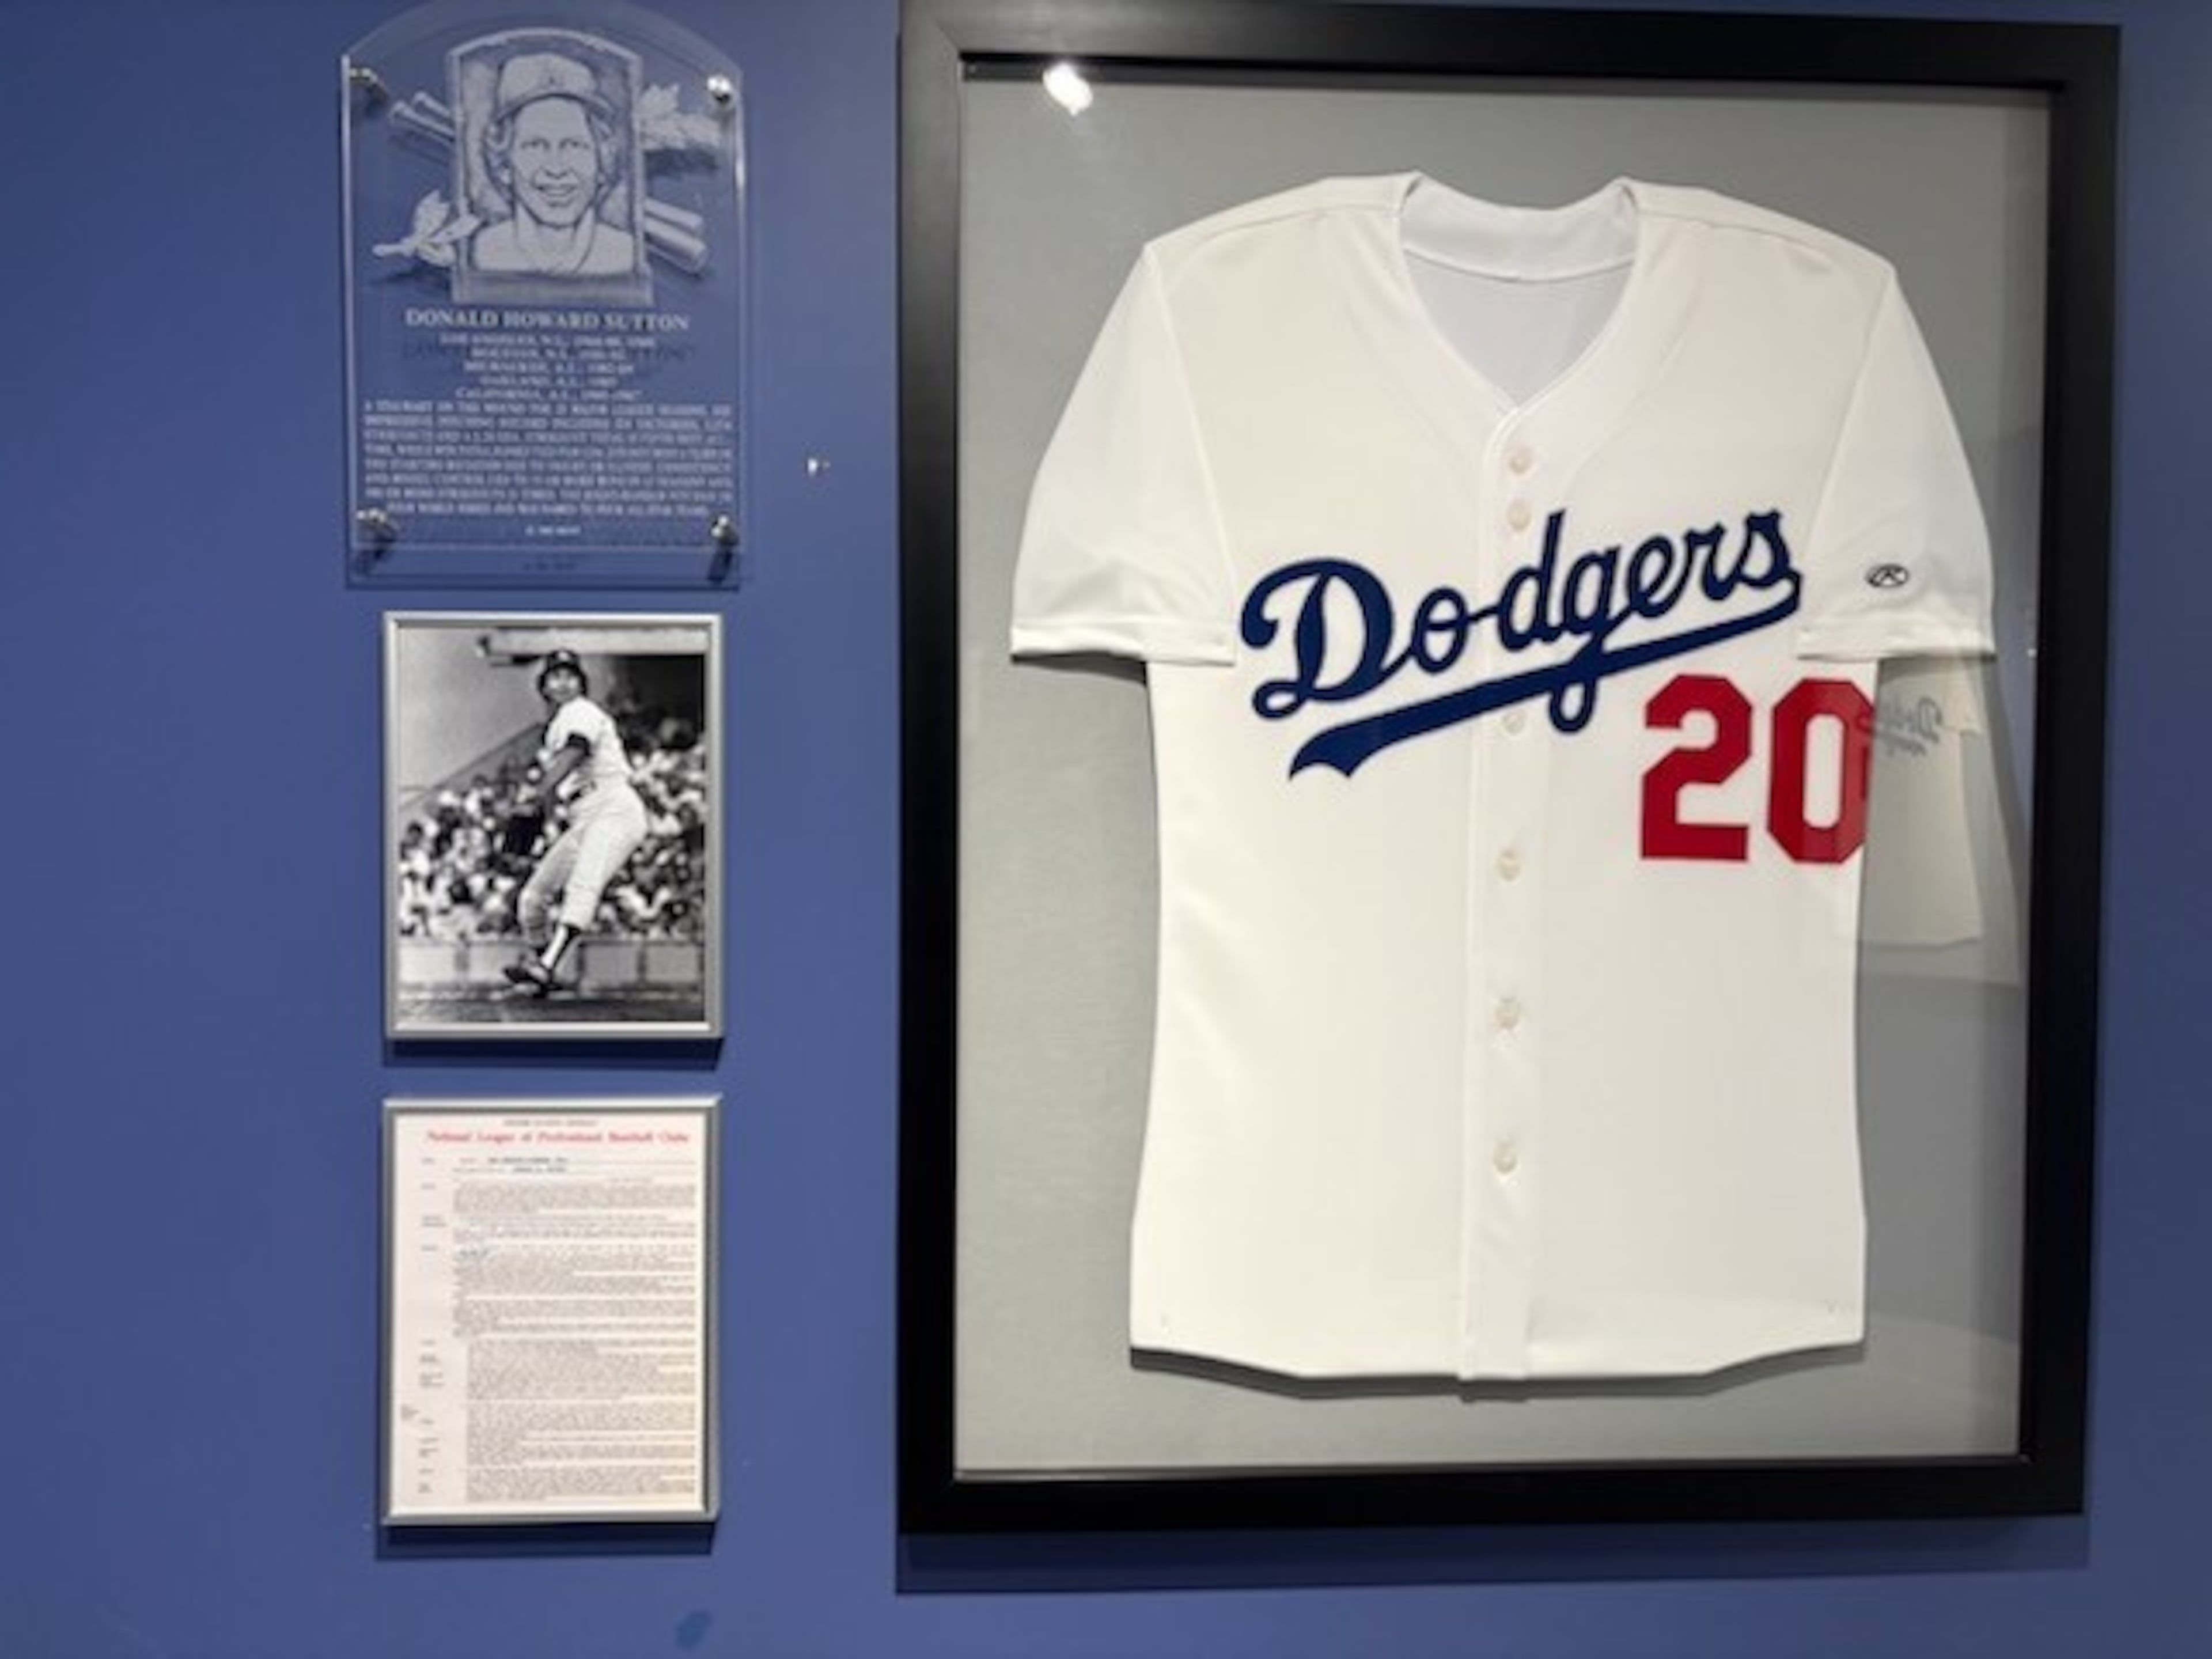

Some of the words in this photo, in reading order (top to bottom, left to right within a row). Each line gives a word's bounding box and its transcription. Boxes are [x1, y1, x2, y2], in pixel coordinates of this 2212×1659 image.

[406, 309, 499, 328] DONALD
[502, 311, 599, 329] HOWARD
[603, 313, 690, 331] SUTTON
[1238, 509, 1803, 779] Dodgers
[1639, 673, 1874, 865] 20
[426, 1130, 472, 1142] National
[476, 1130, 515, 1145] League
